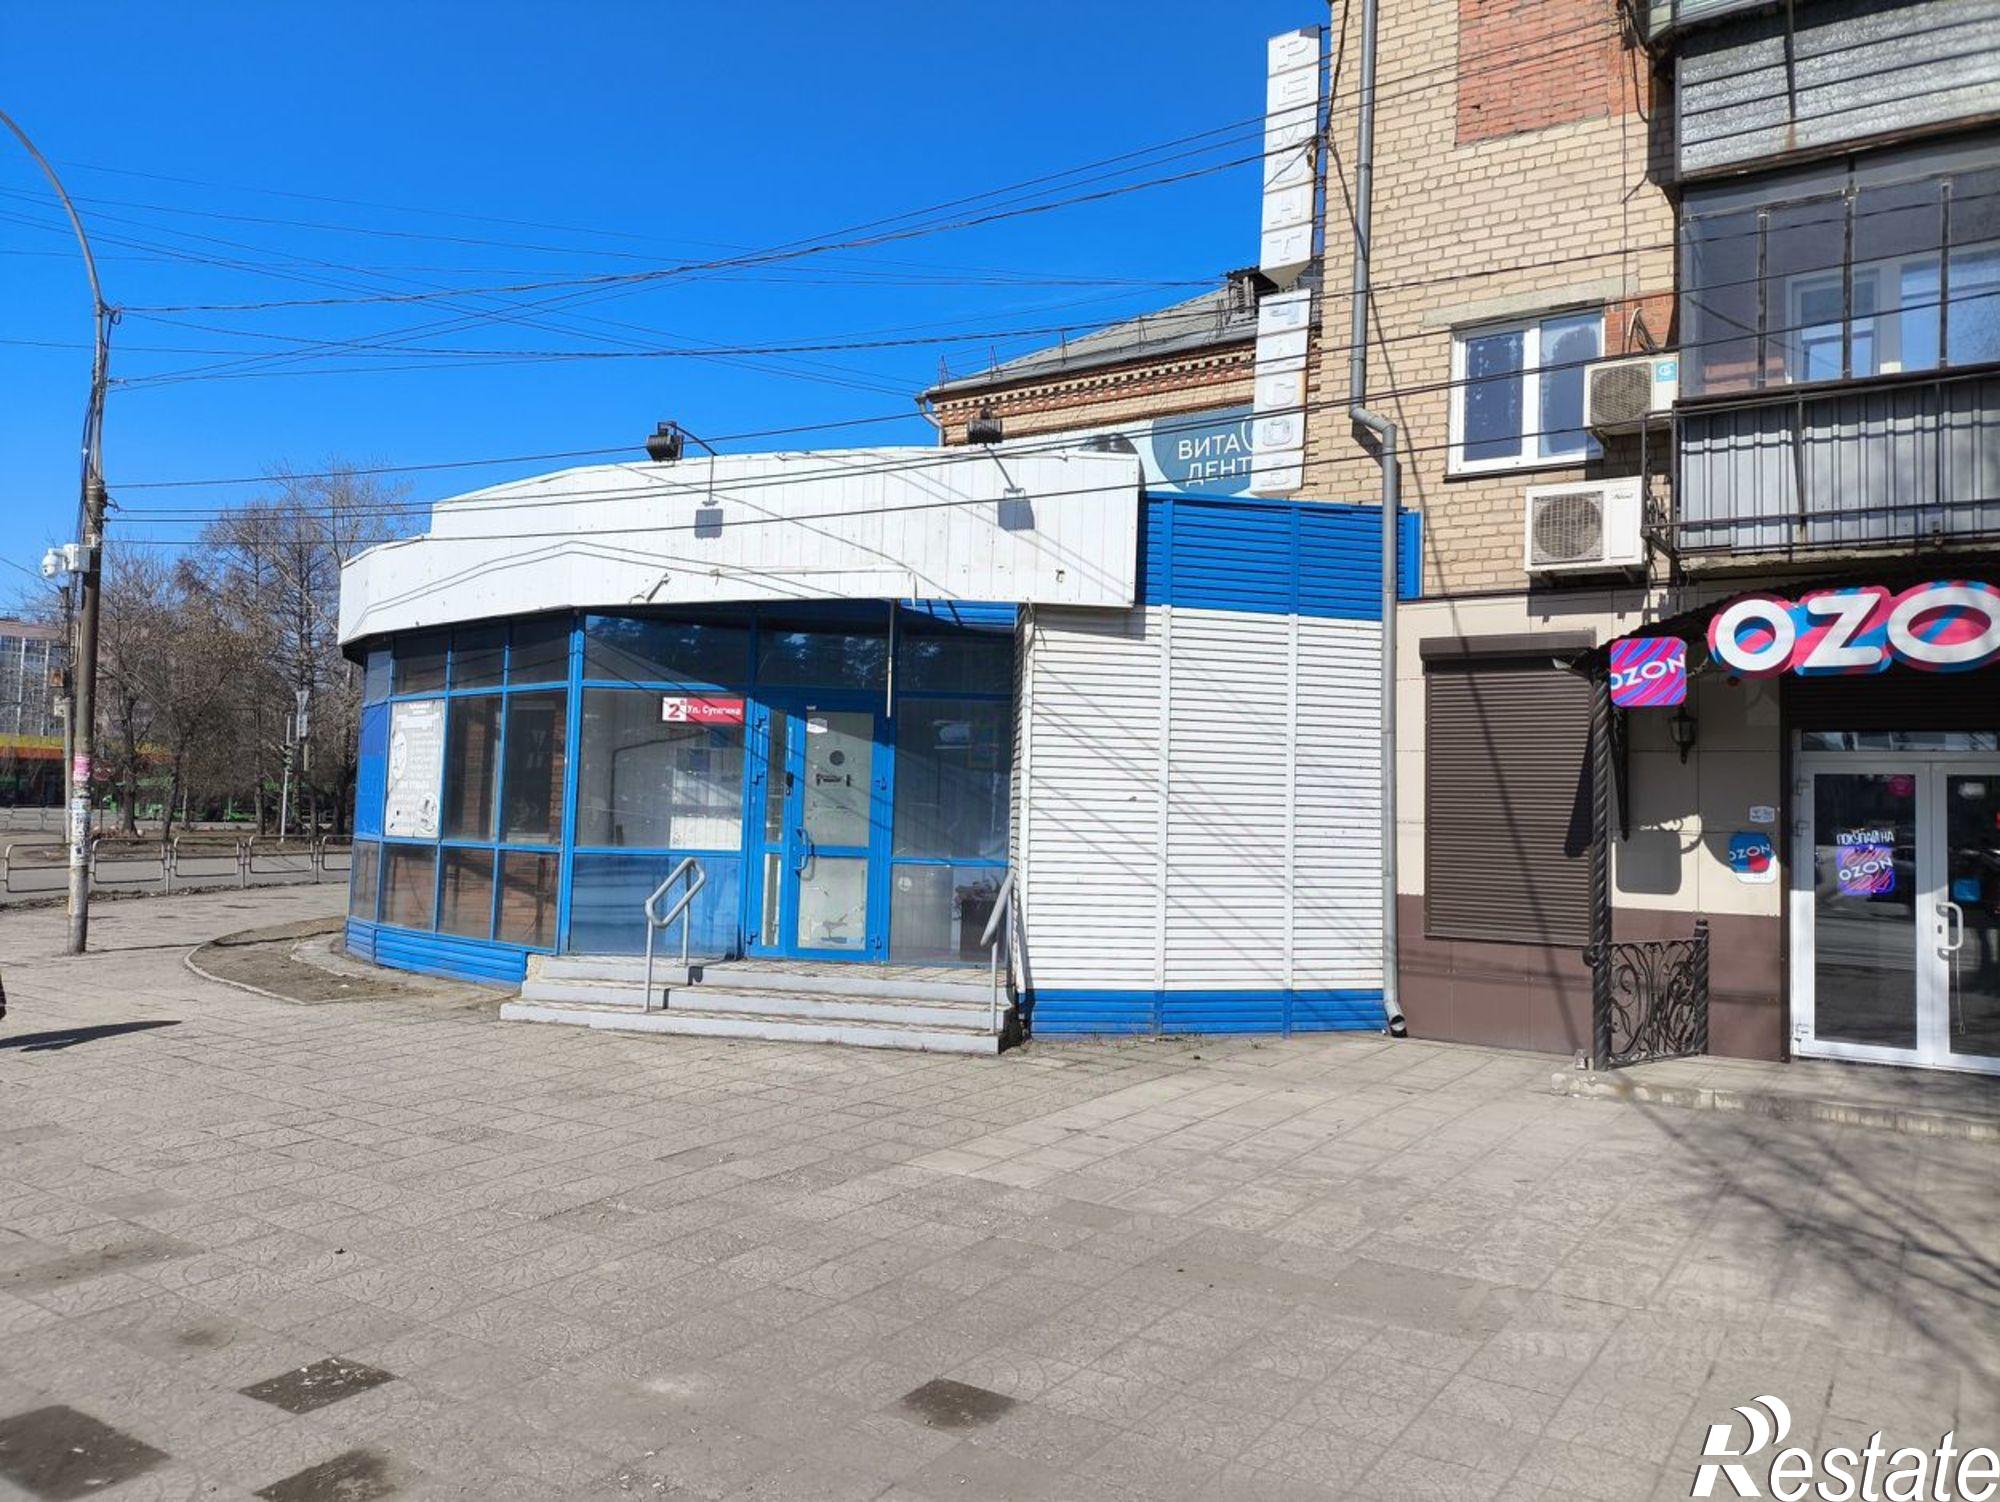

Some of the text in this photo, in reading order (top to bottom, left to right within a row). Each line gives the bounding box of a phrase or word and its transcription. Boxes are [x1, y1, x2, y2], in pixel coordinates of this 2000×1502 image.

[1268, 37, 1313, 264] РЕМОНТ
[1178, 434, 1241, 460] ВИТА
[1185, 456, 1253, 487] ДЕНТ
[1610, 652, 1687, 691] OZON
[1881, 830, 1895, 843] НА
[1729, 842, 1771, 862] OZON
[1839, 857, 1894, 881] OZON
